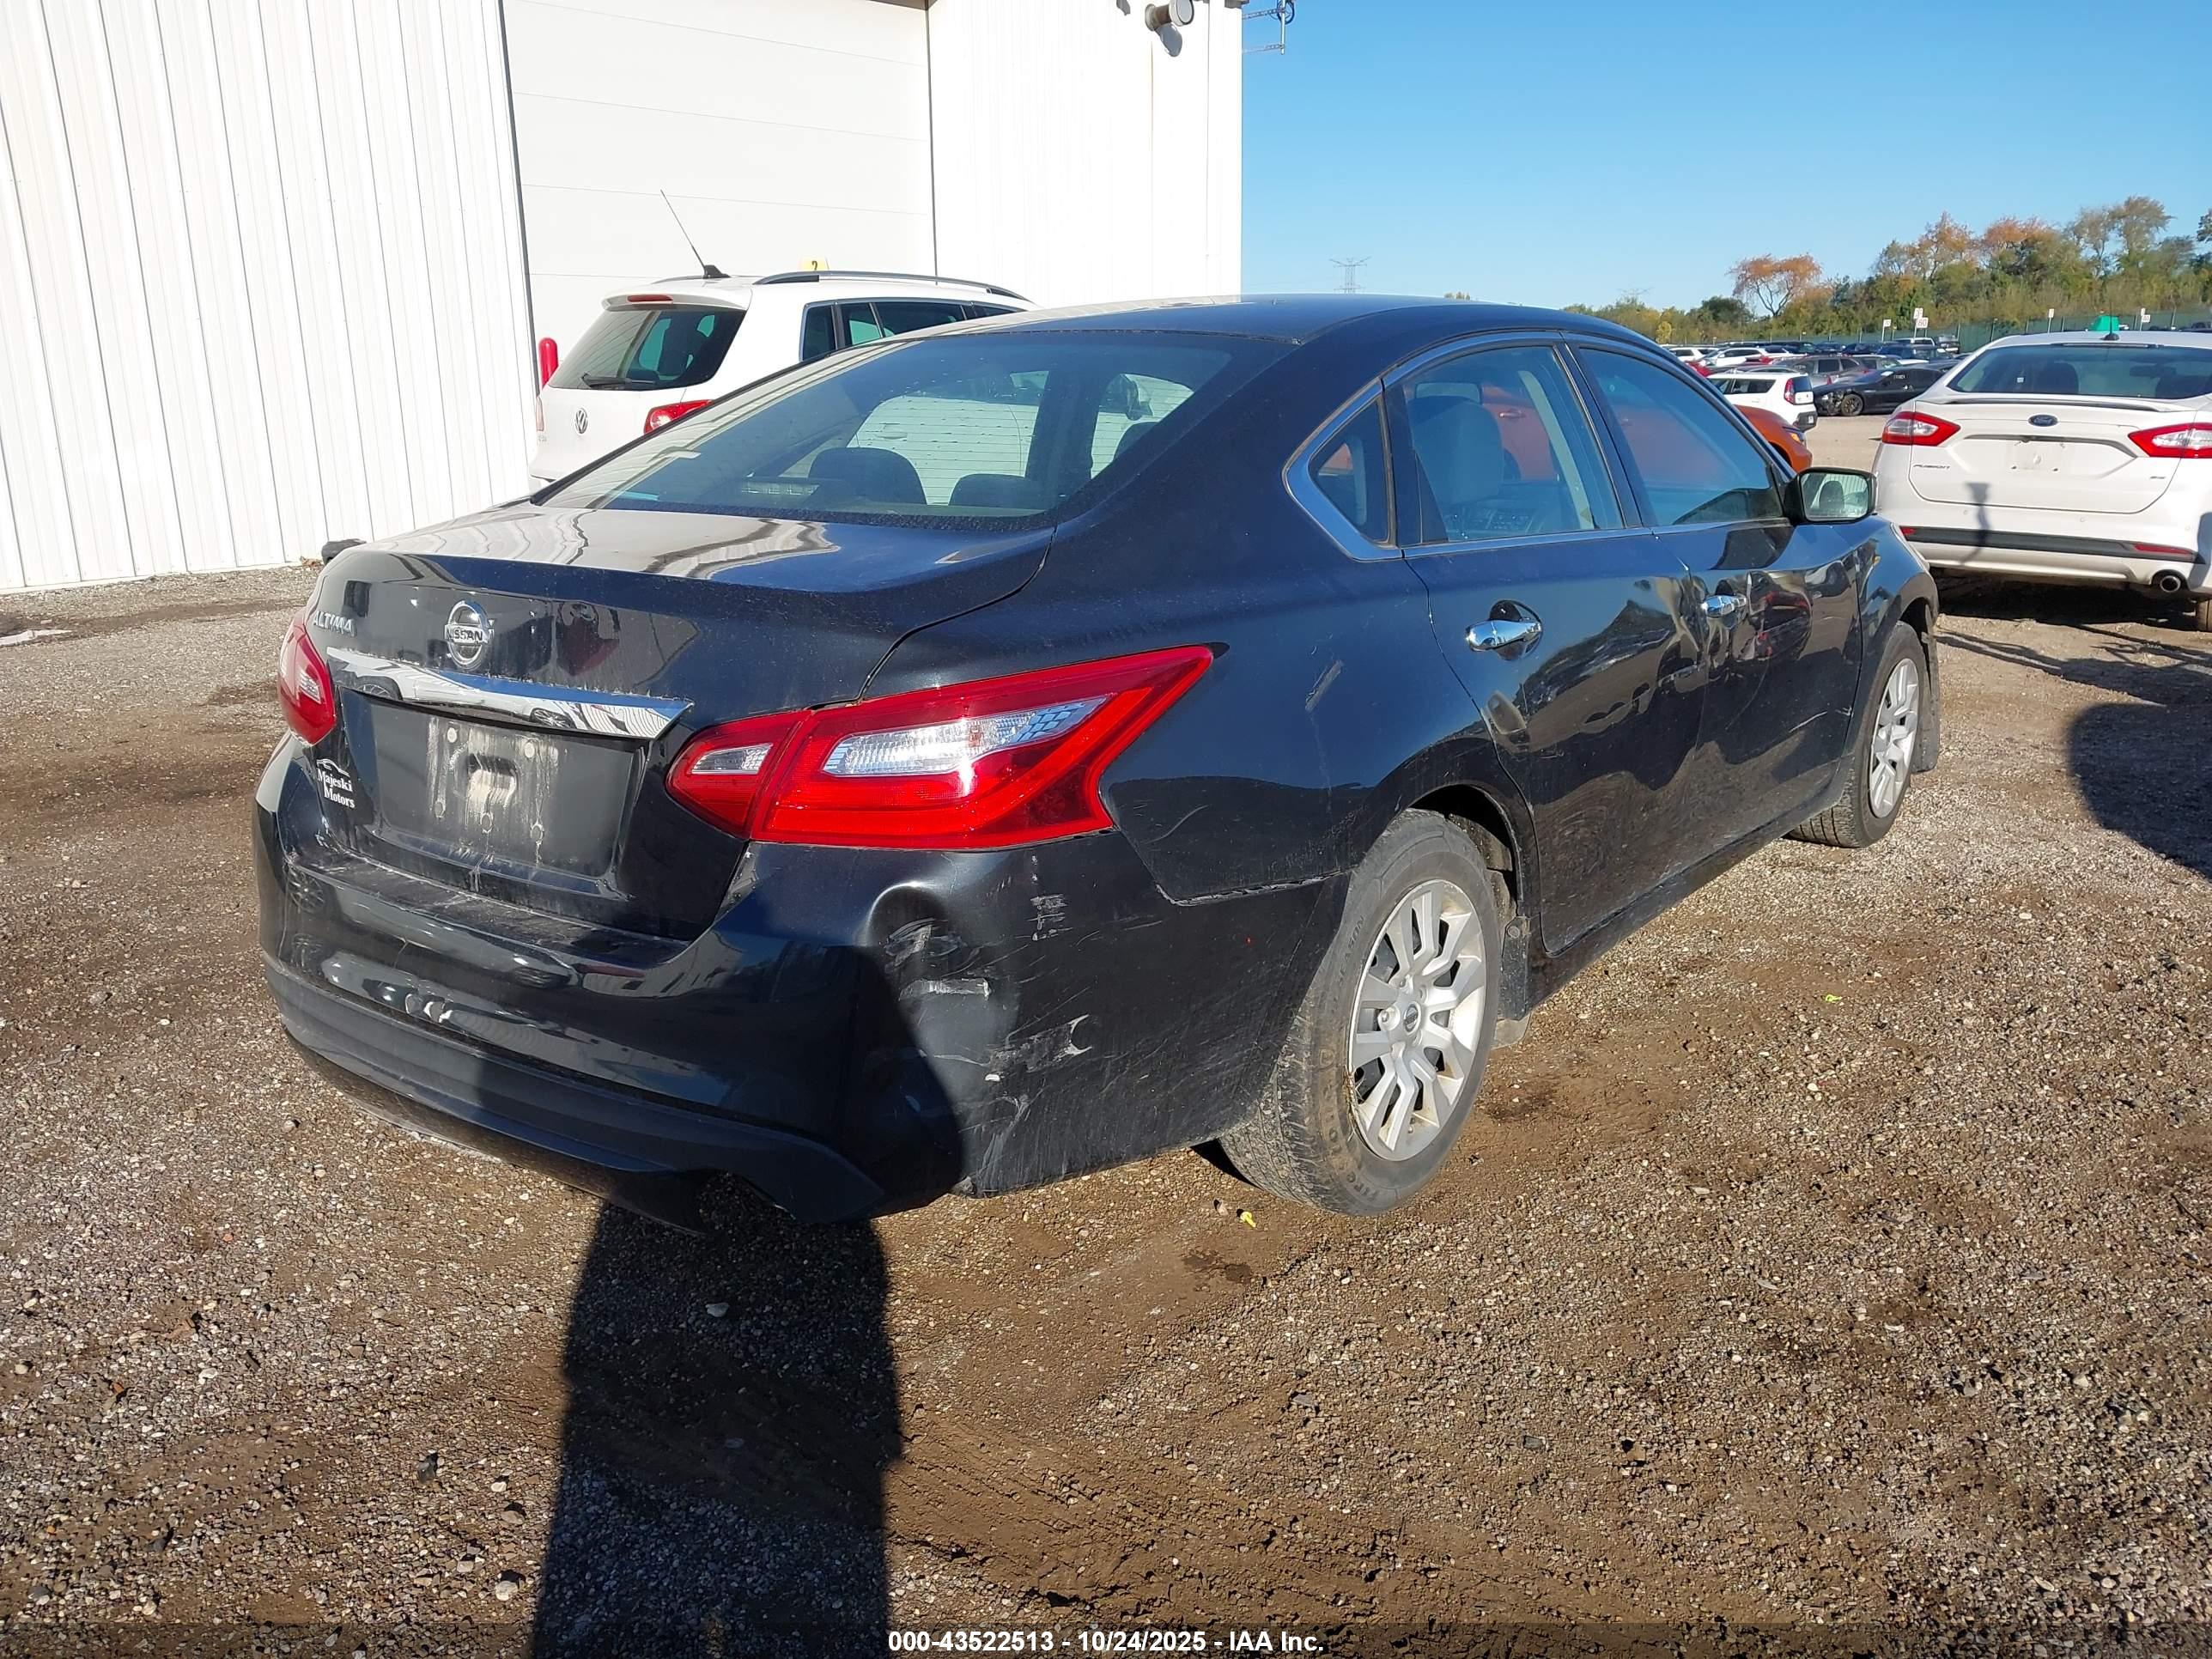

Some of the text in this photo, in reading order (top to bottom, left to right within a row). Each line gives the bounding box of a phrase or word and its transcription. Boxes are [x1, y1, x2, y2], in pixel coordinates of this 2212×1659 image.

[313, 611, 355, 636] ALTIMA
[445, 626, 483, 641] NISSAN
[318, 769, 353, 792] Majeski
[324, 785, 356, 808] Motors
